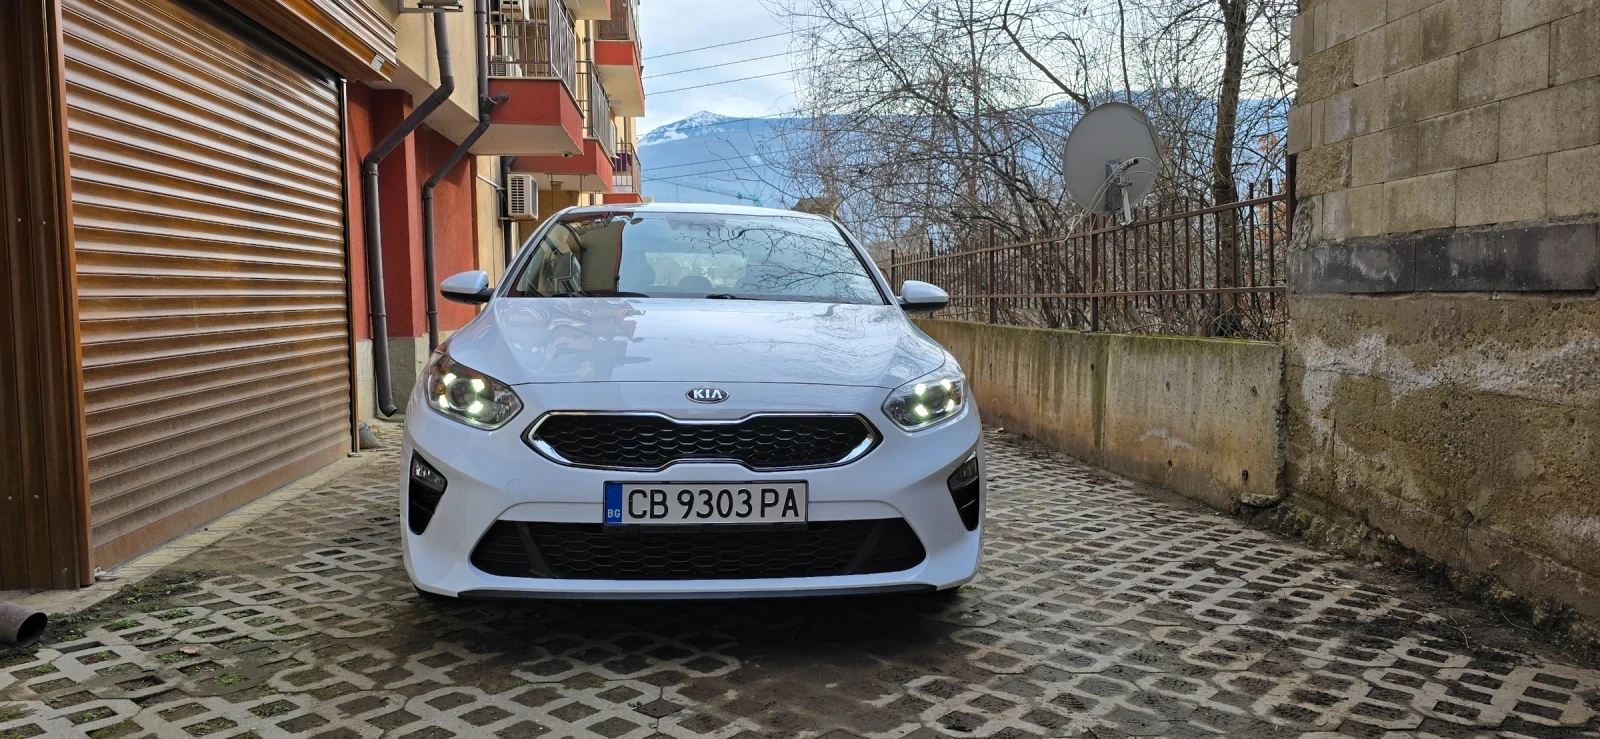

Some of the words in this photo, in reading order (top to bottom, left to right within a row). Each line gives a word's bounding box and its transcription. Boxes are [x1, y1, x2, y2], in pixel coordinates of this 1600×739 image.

[693, 389, 723, 399] KIA
[628, 489, 669, 519] CB
[677, 488, 753, 519] 9303
[760, 488, 800, 518] PA
[607, 508, 621, 518] BG
